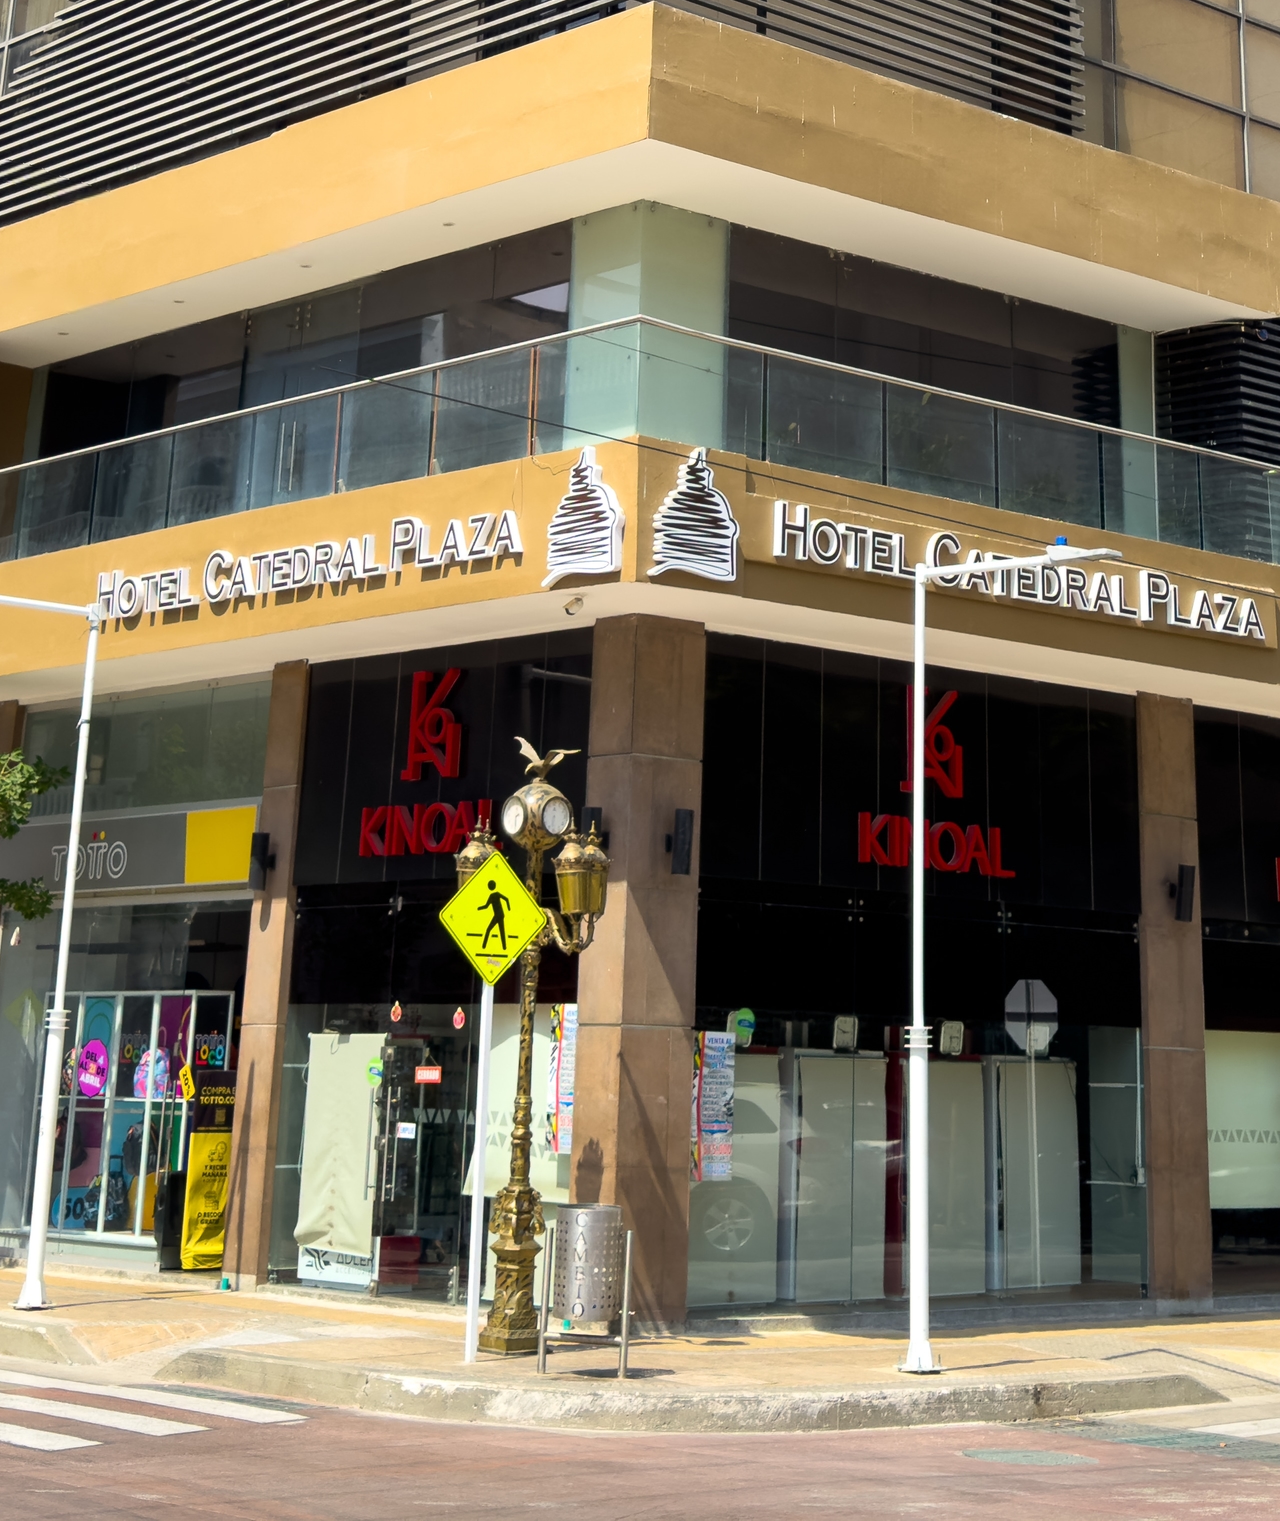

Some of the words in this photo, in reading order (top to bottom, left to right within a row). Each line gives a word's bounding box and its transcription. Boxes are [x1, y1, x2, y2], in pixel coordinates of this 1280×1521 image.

[98, 566, 200, 619] HOTEL
[202, 533, 389, 604] CATEDRAL
[389, 509, 525, 573] PLAZA
[773, 500, 917, 580] HOTEL
[926, 532, 1139, 619] CATEDRAL
[1139, 570, 1266, 640] PLAZA
[51, 841, 128, 881] TOTTO
[359, 798, 504, 857] KINOAL
[858, 811, 1016, 879] KINOAL
[85, 1050, 97, 1063] DEL
[572, 1213, 589, 1318] CAMBIO
